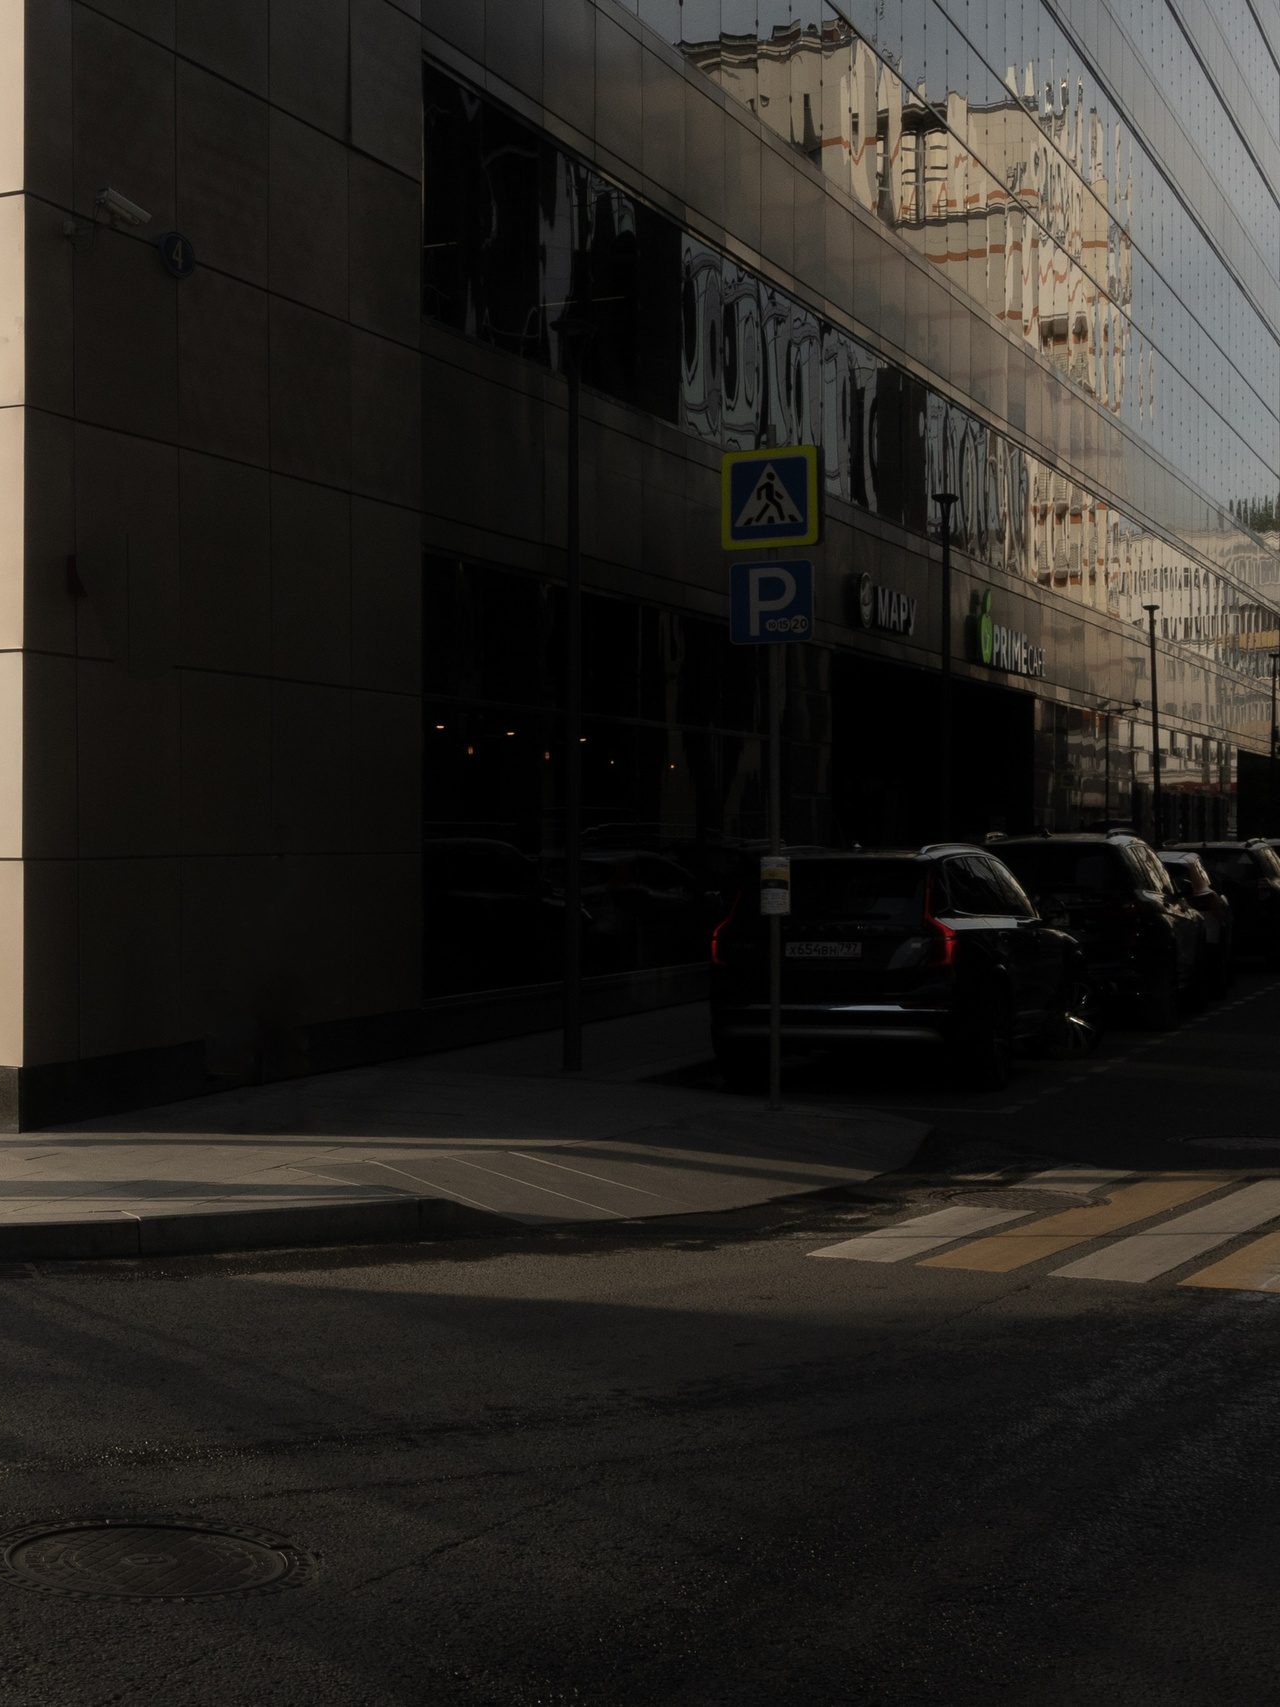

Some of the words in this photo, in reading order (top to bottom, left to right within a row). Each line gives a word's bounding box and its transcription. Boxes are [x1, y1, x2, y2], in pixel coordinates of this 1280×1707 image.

[171, 239, 184, 271] 4
[748, 566, 797, 637] P
[778, 620, 789, 630] 15
[792, 618, 808, 630] 20
